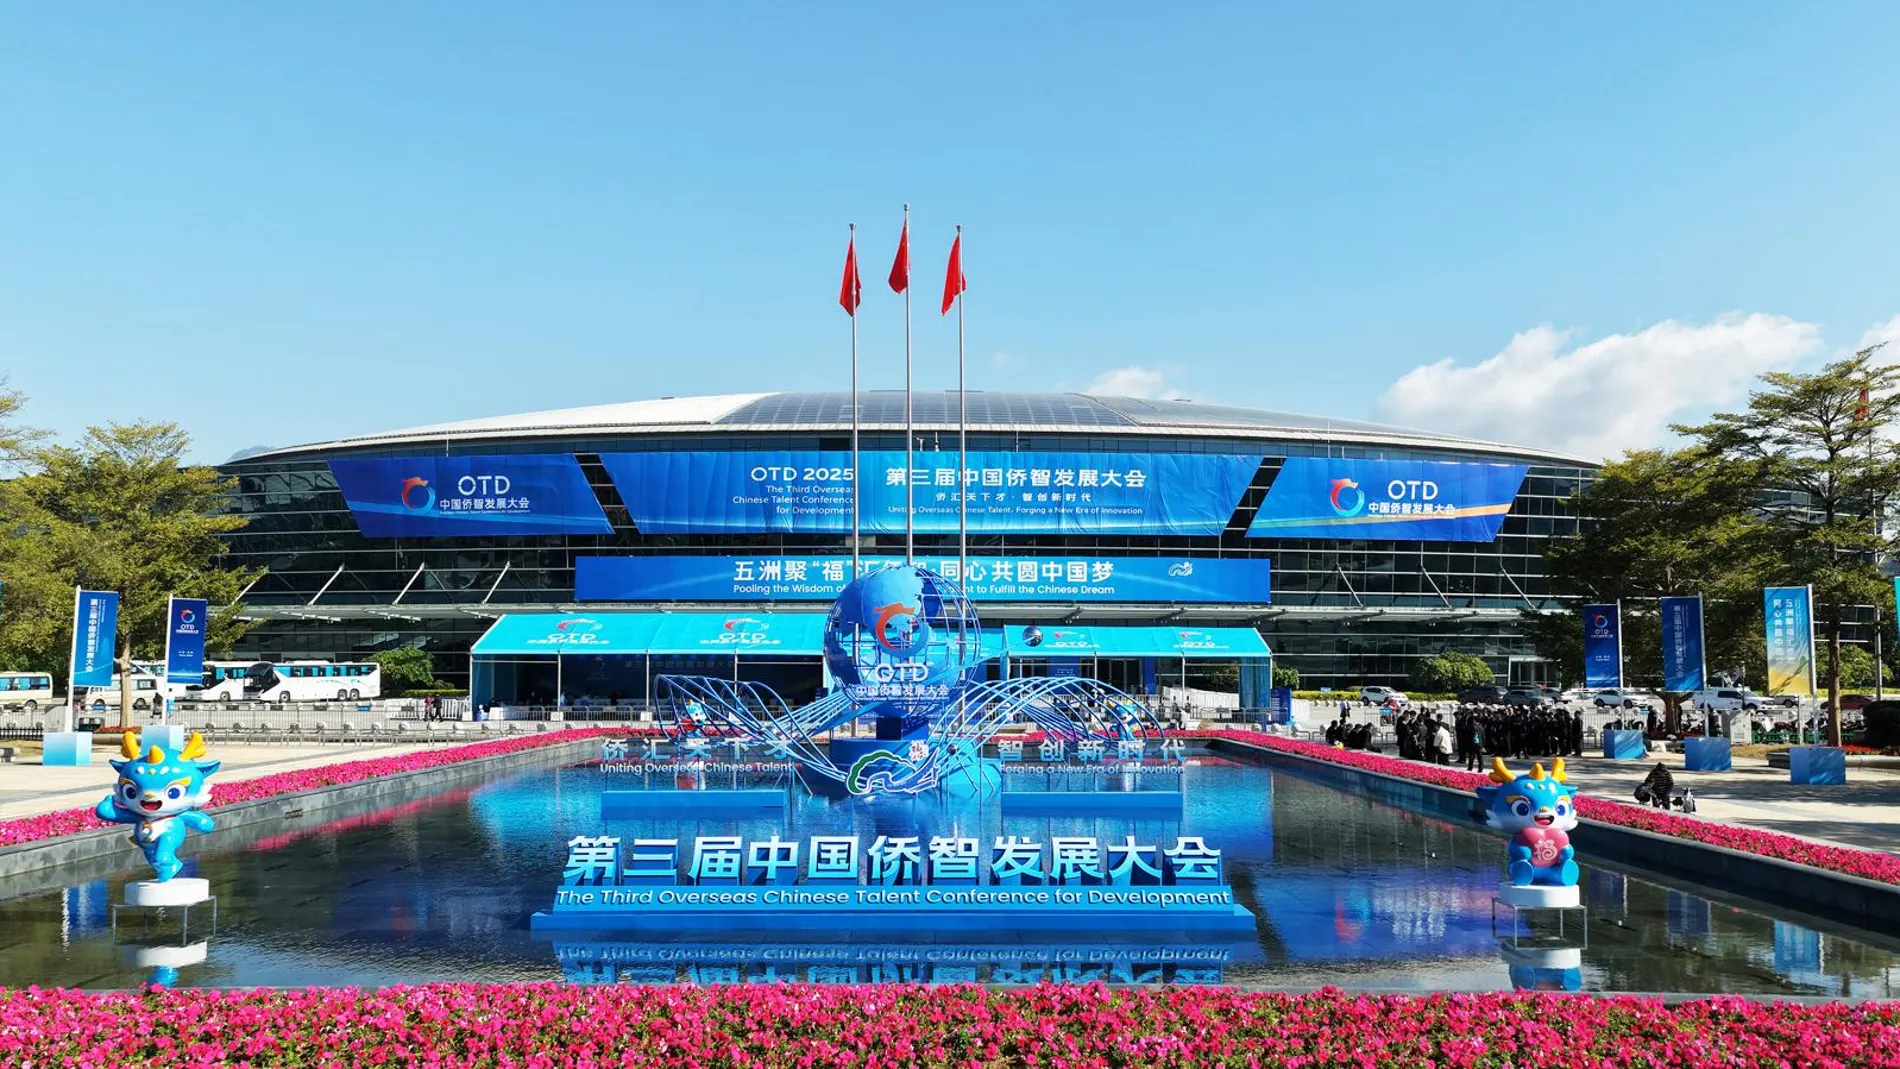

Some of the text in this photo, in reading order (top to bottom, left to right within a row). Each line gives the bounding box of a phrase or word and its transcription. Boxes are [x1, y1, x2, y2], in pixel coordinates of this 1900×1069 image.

[751, 467, 854, 481] OTD 2025
[886, 467, 1147, 488] 第三届中国侨智发展大会
[457, 475, 510, 496] OTD
[766, 485, 783, 493] The
[786, 485, 810, 493] Third
[1387, 479, 1439, 500] OTD
[440, 497, 530, 510] 中国侨智发展大会
[732, 495, 769, 504] Chinese
[772, 495, 800, 504] Talent
[776, 506, 790, 514] for
[888, 506, 917, 515] Unitig
[918, 506, 954, 514] Overseas
[1016, 506, 1047, 516] Forging
[1054, 506, 1073, 514] New
[1075, 506, 1089, 514] Era
[1090, 506, 1100, 514] of
[1101, 507, 1144, 515] Innovation
[1368, 502, 1456, 514] 中国侨智发展大会
[733, 584, 769, 594] Pooling
[773, 584, 789, 593] the
[792, 584, 833, 593] Wisdom
[976, 585, 987, 594] to
[989, 585, 1016, 594] Fulfill
[1018, 585, 1035, 594] the
[1037, 585, 1078, 594] Chinese
[1081, 586, 1115, 595] Dream
[547, 633, 596, 641] OTD
[719, 632, 766, 641] OTD
[875, 663, 929, 682] OTD
[998, 739, 1187, 762] 智创新时代
[600, 763, 642, 775] Uniting
[703, 763, 751, 774] Chinese
[755, 763, 793, 774] Talent
[1000, 764, 1044, 775] Forging
[1058, 764, 1082, 774] New
[1086, 764, 1104, 774] Era
[1107, 764, 1119, 774] of
[1122, 764, 1185, 775] Iovation
[563, 835, 1221, 880] 第三届中国侨智发展大会
[556, 889, 1230, 908] The Third Overseas Chinese Talent Conference for Development
